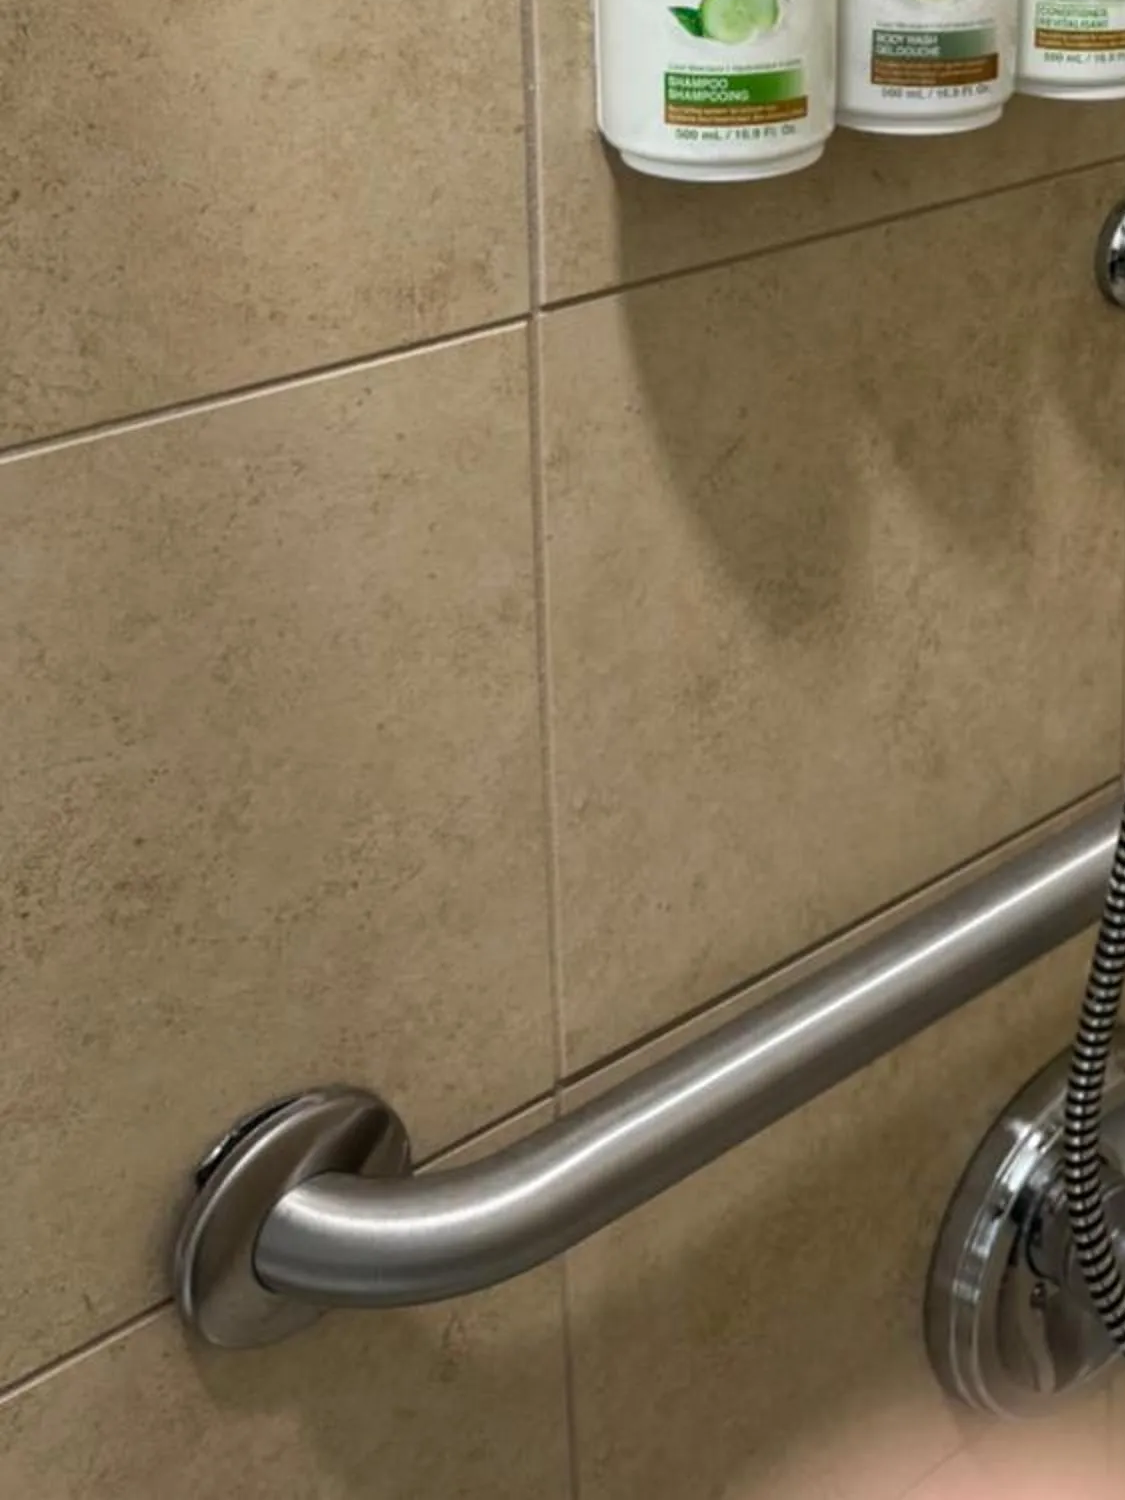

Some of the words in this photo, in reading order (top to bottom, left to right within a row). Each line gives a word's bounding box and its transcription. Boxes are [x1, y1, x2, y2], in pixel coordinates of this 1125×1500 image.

[907, 33, 939, 45] WASH
[668, 75, 729, 90] SHAMPOO
[668, 88, 749, 102] SHAMPOOING
